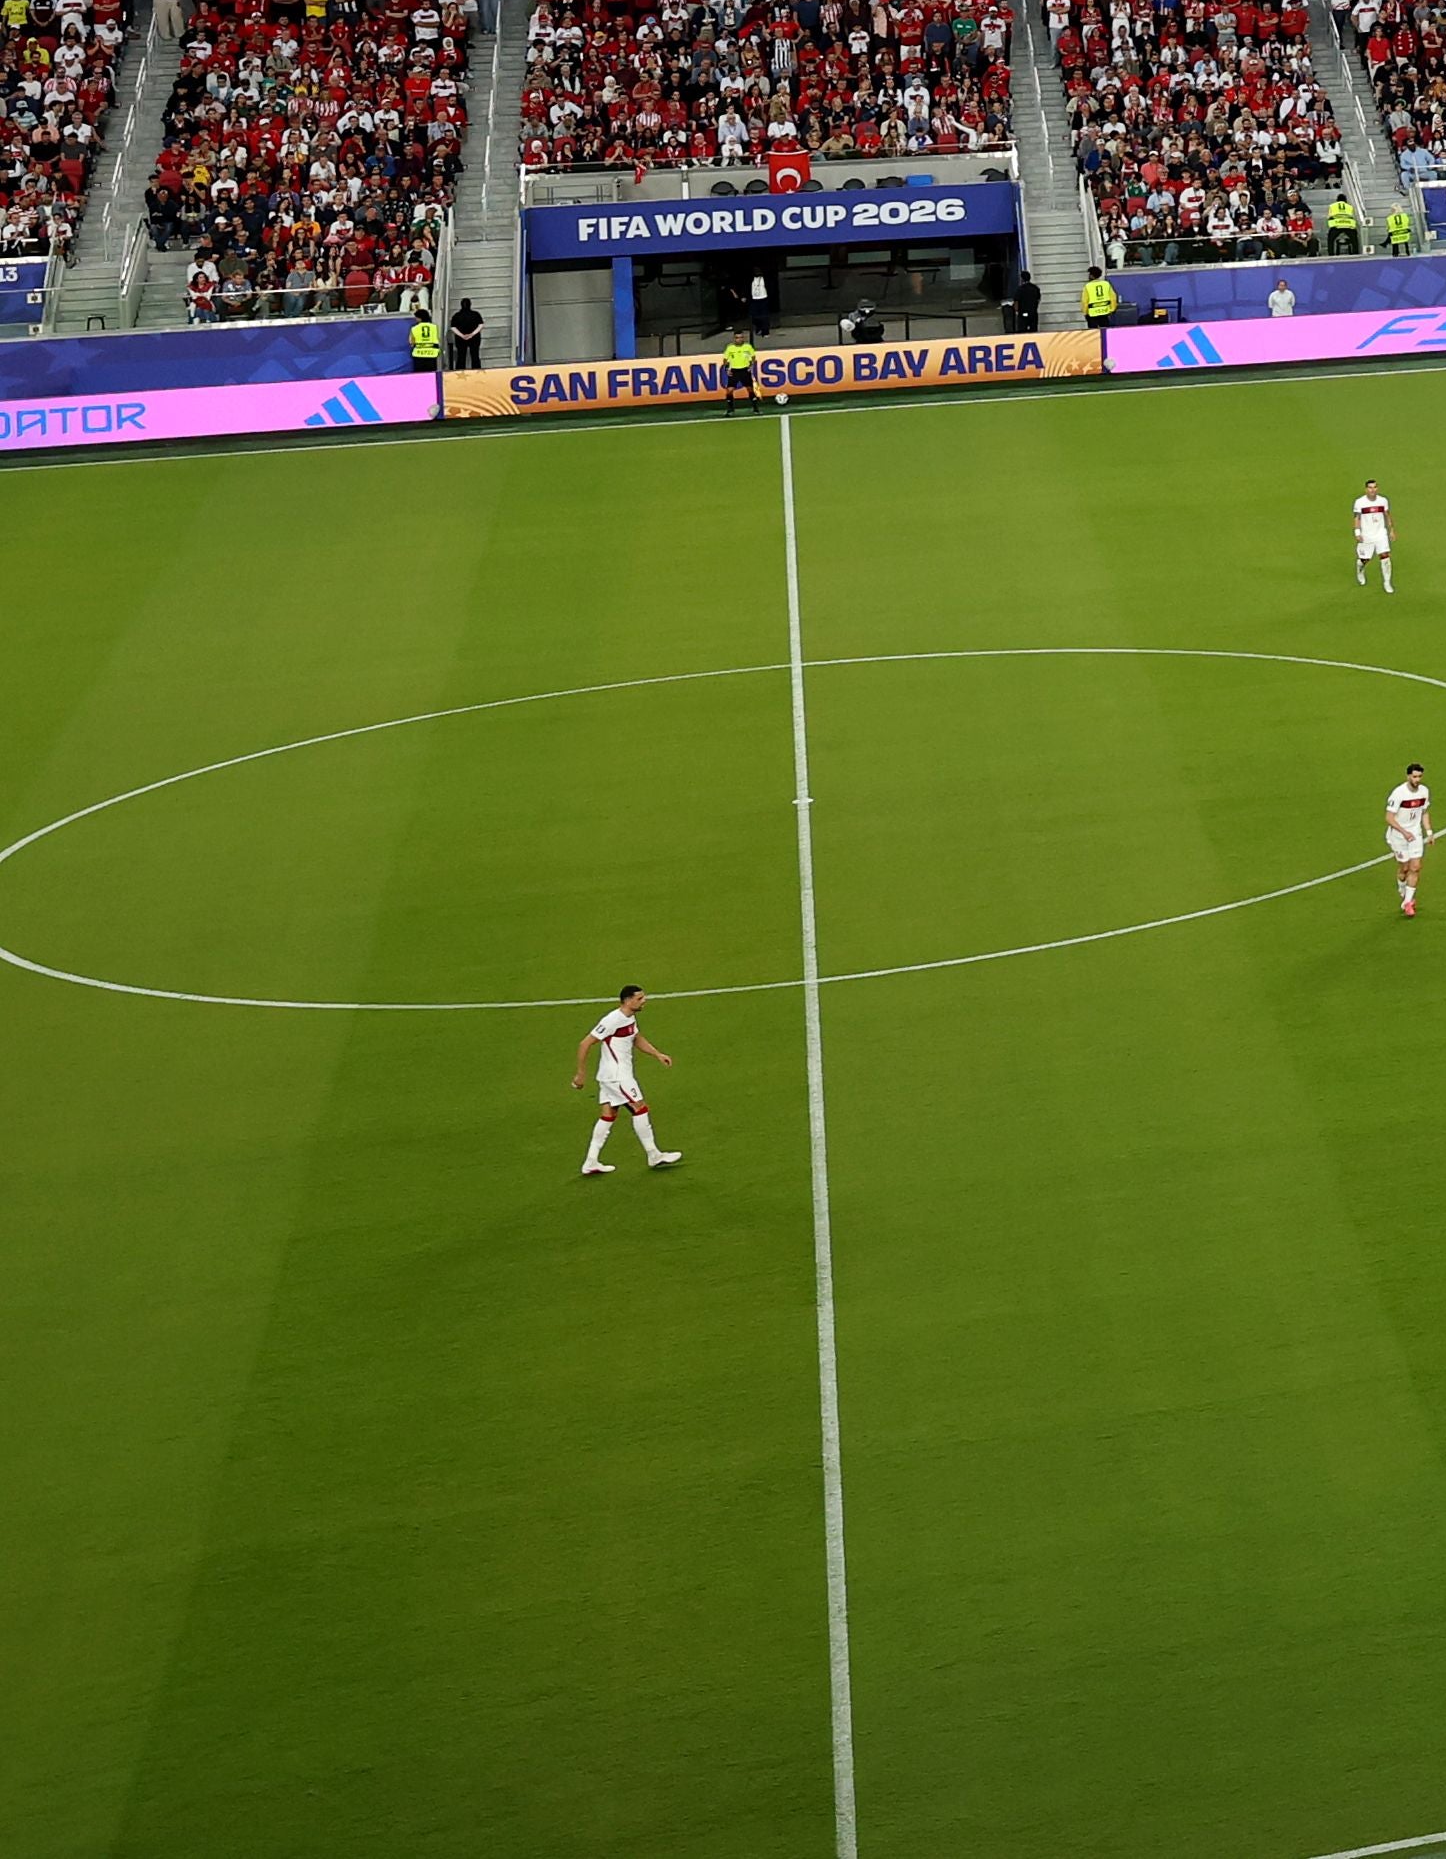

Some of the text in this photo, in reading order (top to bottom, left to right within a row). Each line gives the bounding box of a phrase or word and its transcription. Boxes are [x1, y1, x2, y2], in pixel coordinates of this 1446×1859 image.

[579, 199, 965, 241] FIFA WORLD CUP 2026
[510, 372, 597, 405] SAN
[853, 348, 928, 382] BAY
[938, 341, 1044, 376] AREA
